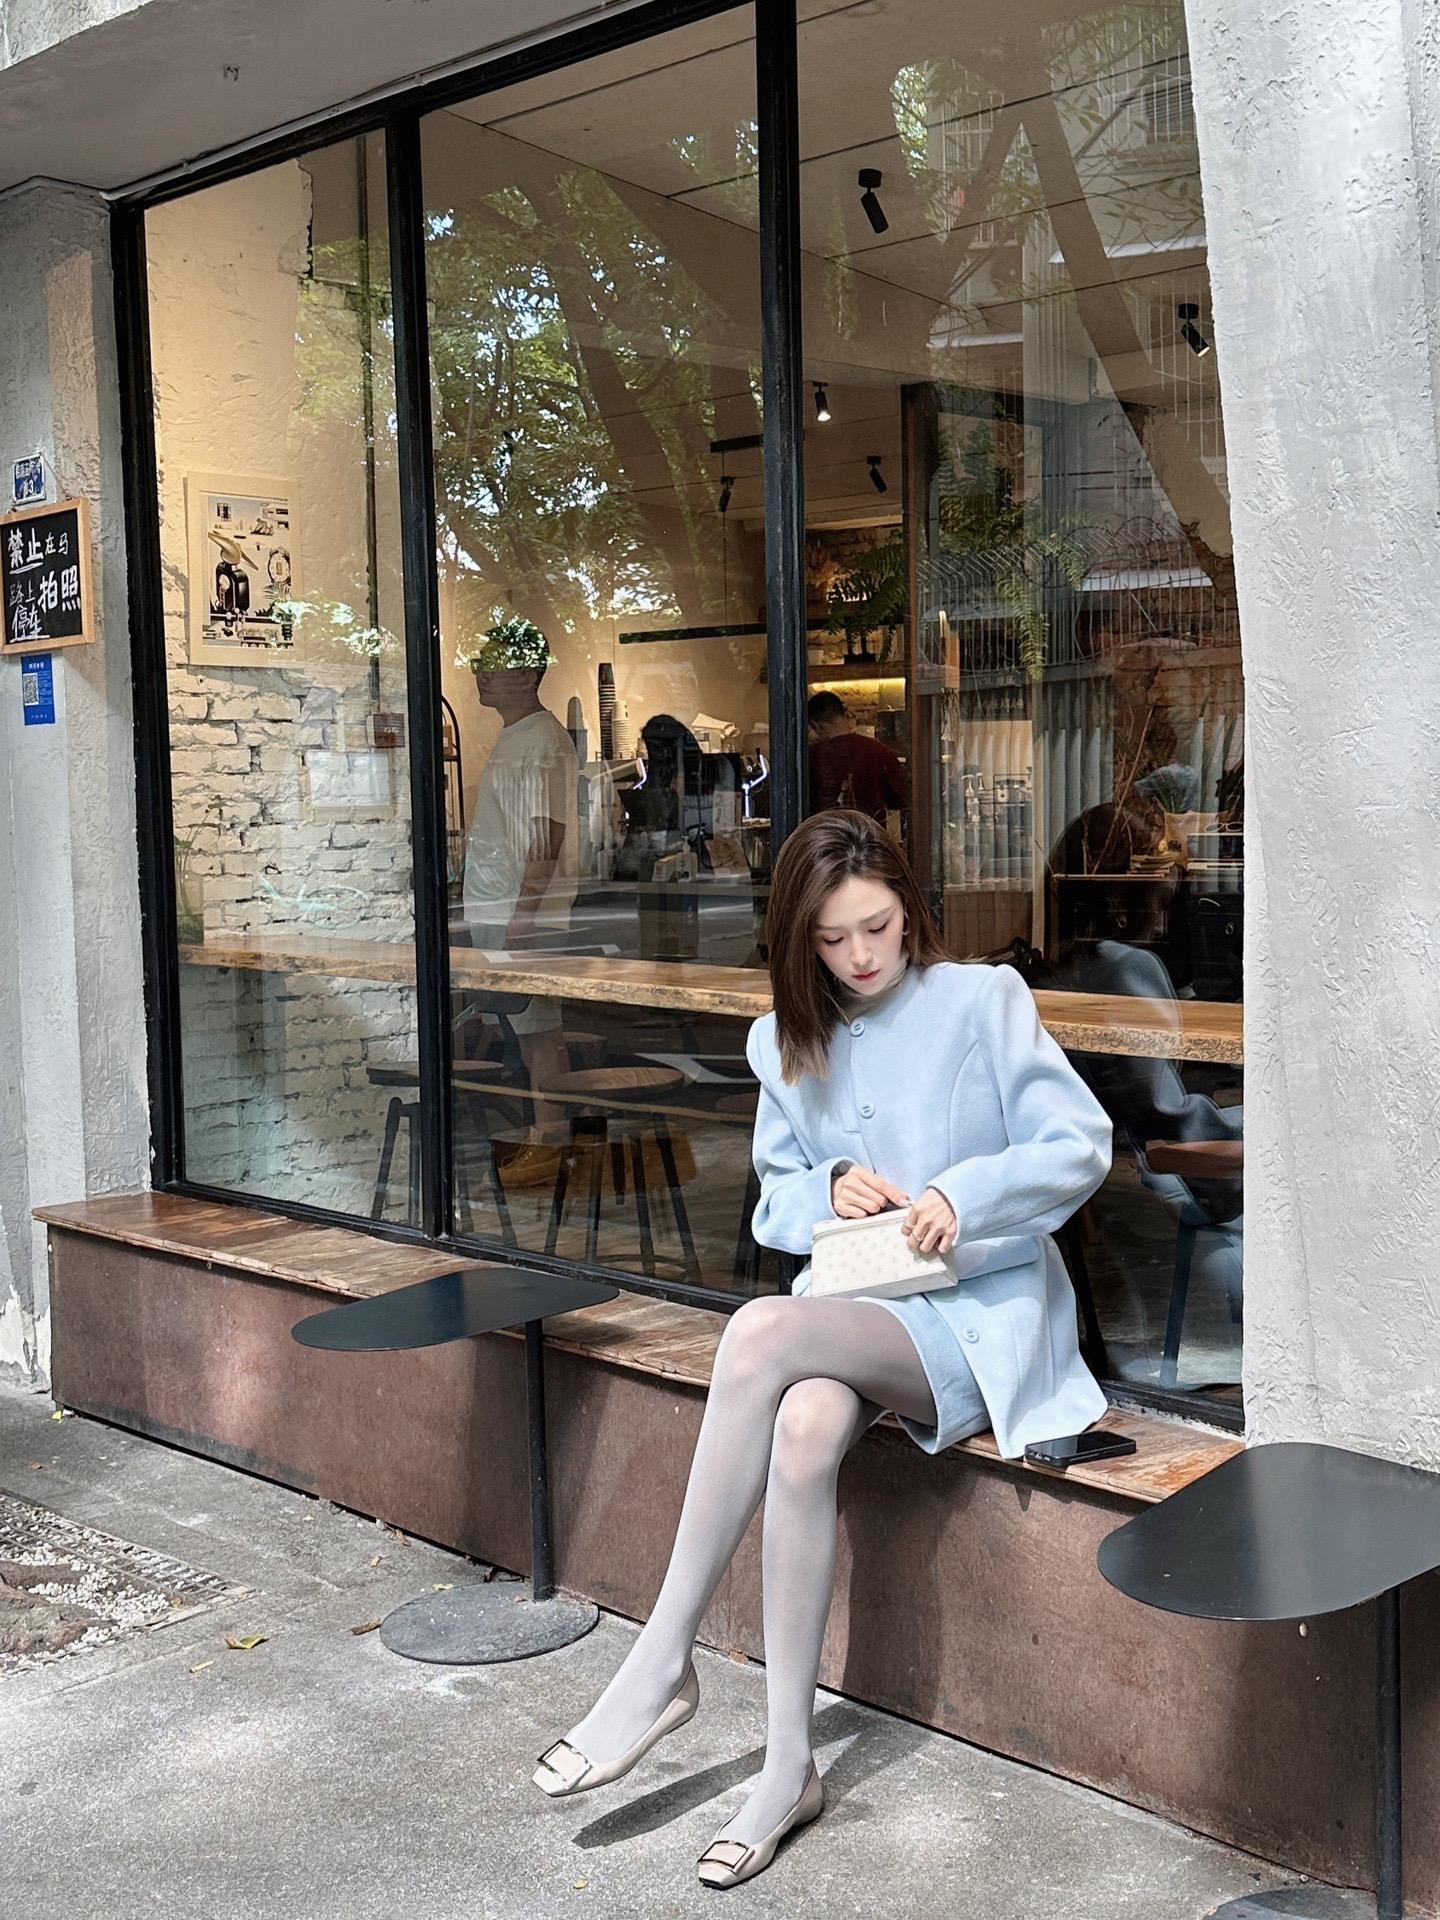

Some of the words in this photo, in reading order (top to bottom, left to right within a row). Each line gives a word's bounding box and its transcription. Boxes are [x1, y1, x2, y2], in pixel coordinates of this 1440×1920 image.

[8, 527, 68, 568] 禁止在马
[11, 603, 43, 639] 停车
